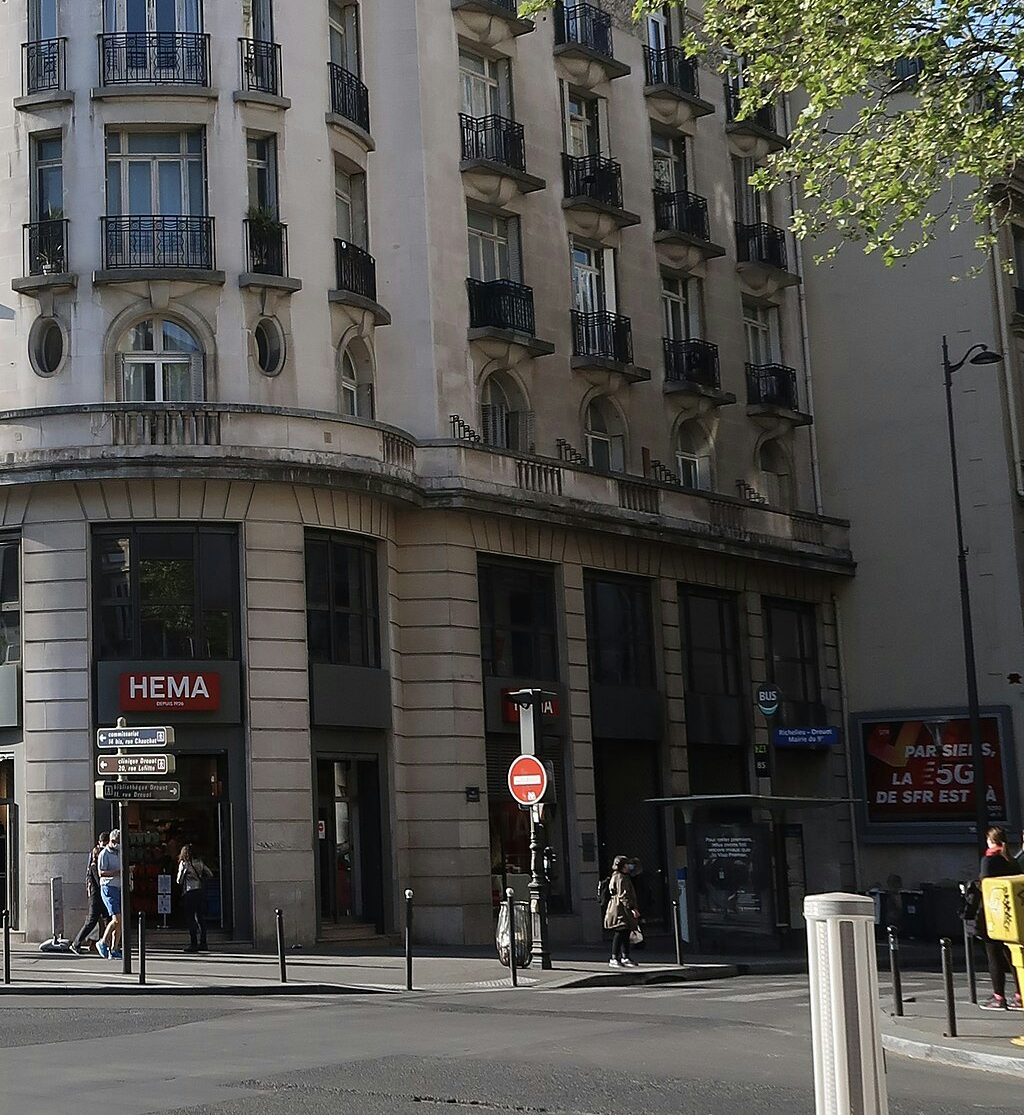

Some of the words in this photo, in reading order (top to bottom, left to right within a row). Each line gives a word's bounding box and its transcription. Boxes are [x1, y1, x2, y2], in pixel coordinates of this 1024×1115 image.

[130, 676, 210, 698] HEMA
[759, 691, 777, 701] BUS
[905, 742, 996, 758] PARSIES,
[892, 772, 913, 785] LA
[936, 763, 974, 785] 5G
[876, 790, 897, 804] DE
[902, 790, 933, 803] SFR
[939, 789, 970, 803] EST
[985, 785, 997, 802] À
